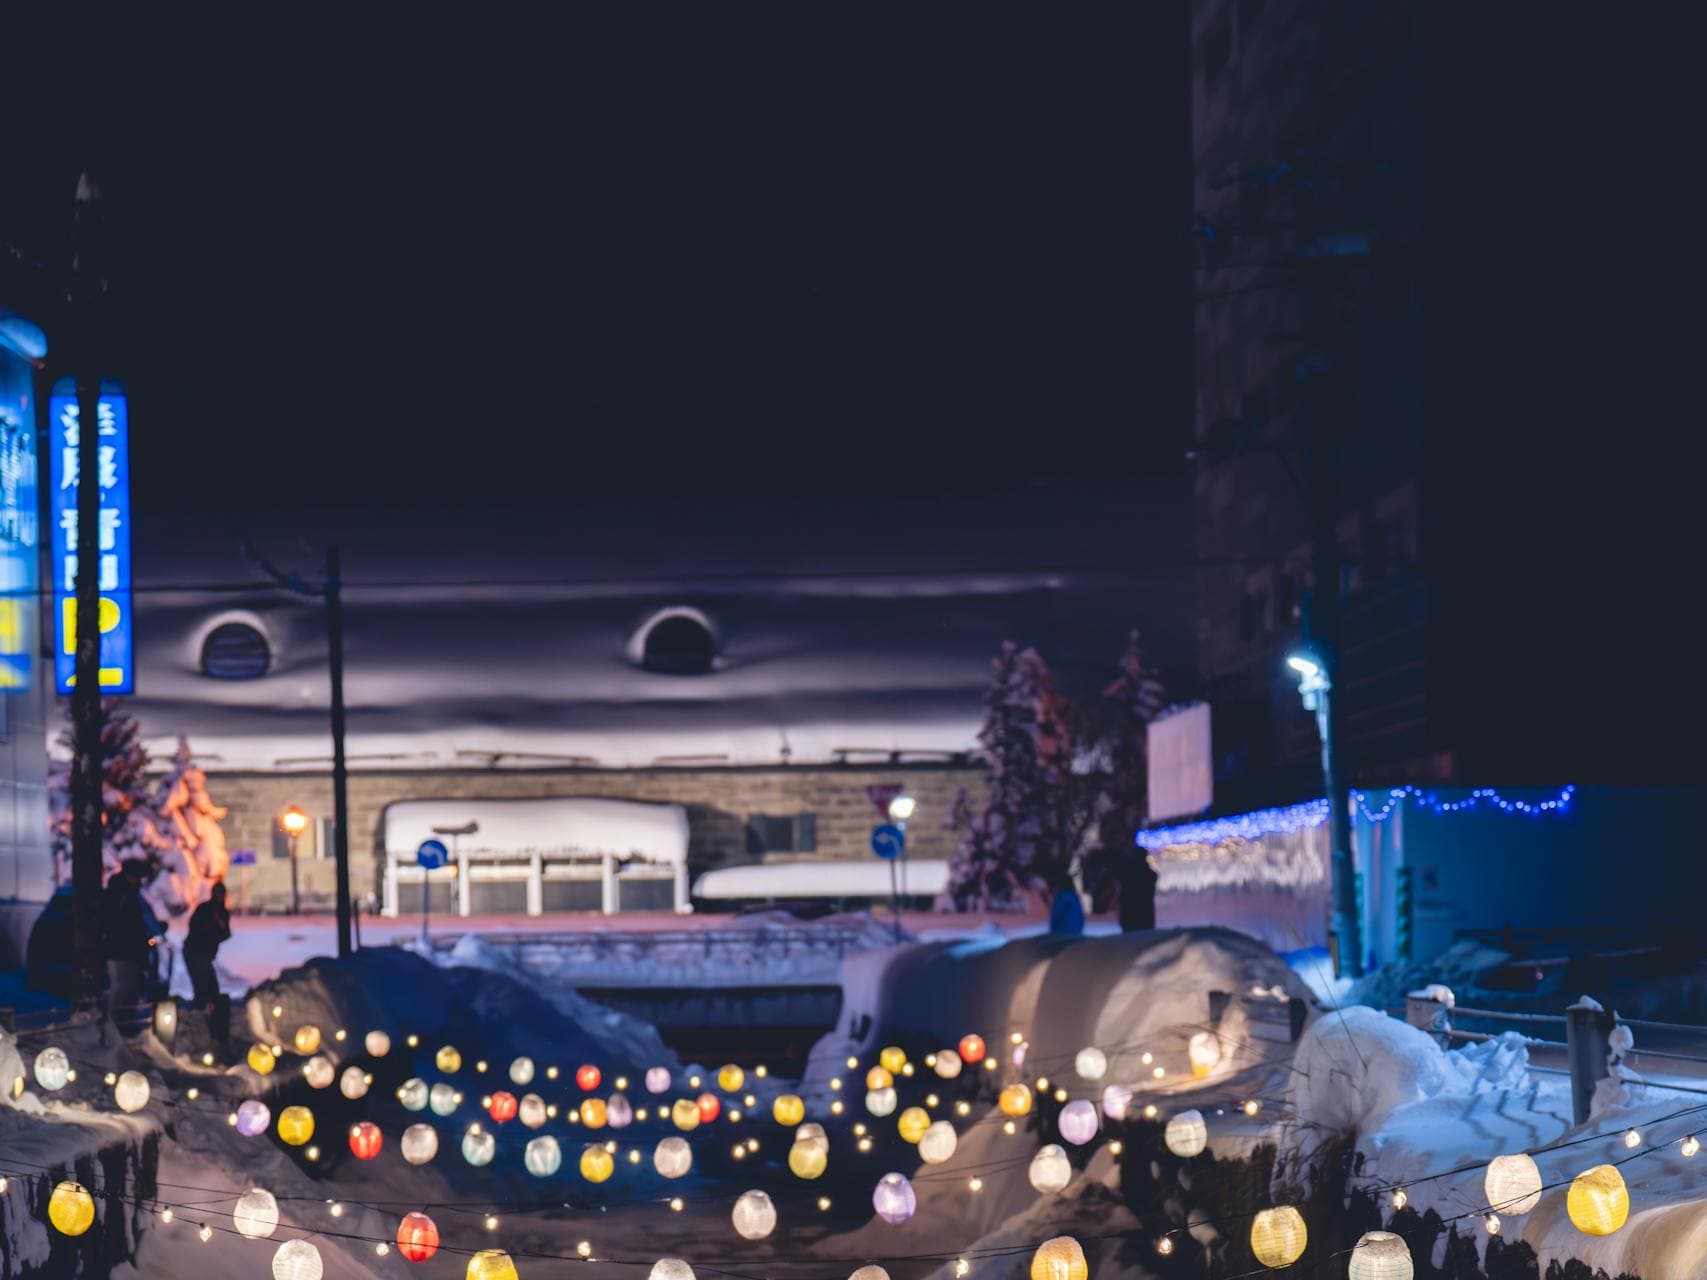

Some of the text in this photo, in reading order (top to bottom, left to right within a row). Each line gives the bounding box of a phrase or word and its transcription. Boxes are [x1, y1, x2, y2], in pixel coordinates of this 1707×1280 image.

[59, 402, 122, 592] 洋服青山
[62, 596, 121, 655] P
